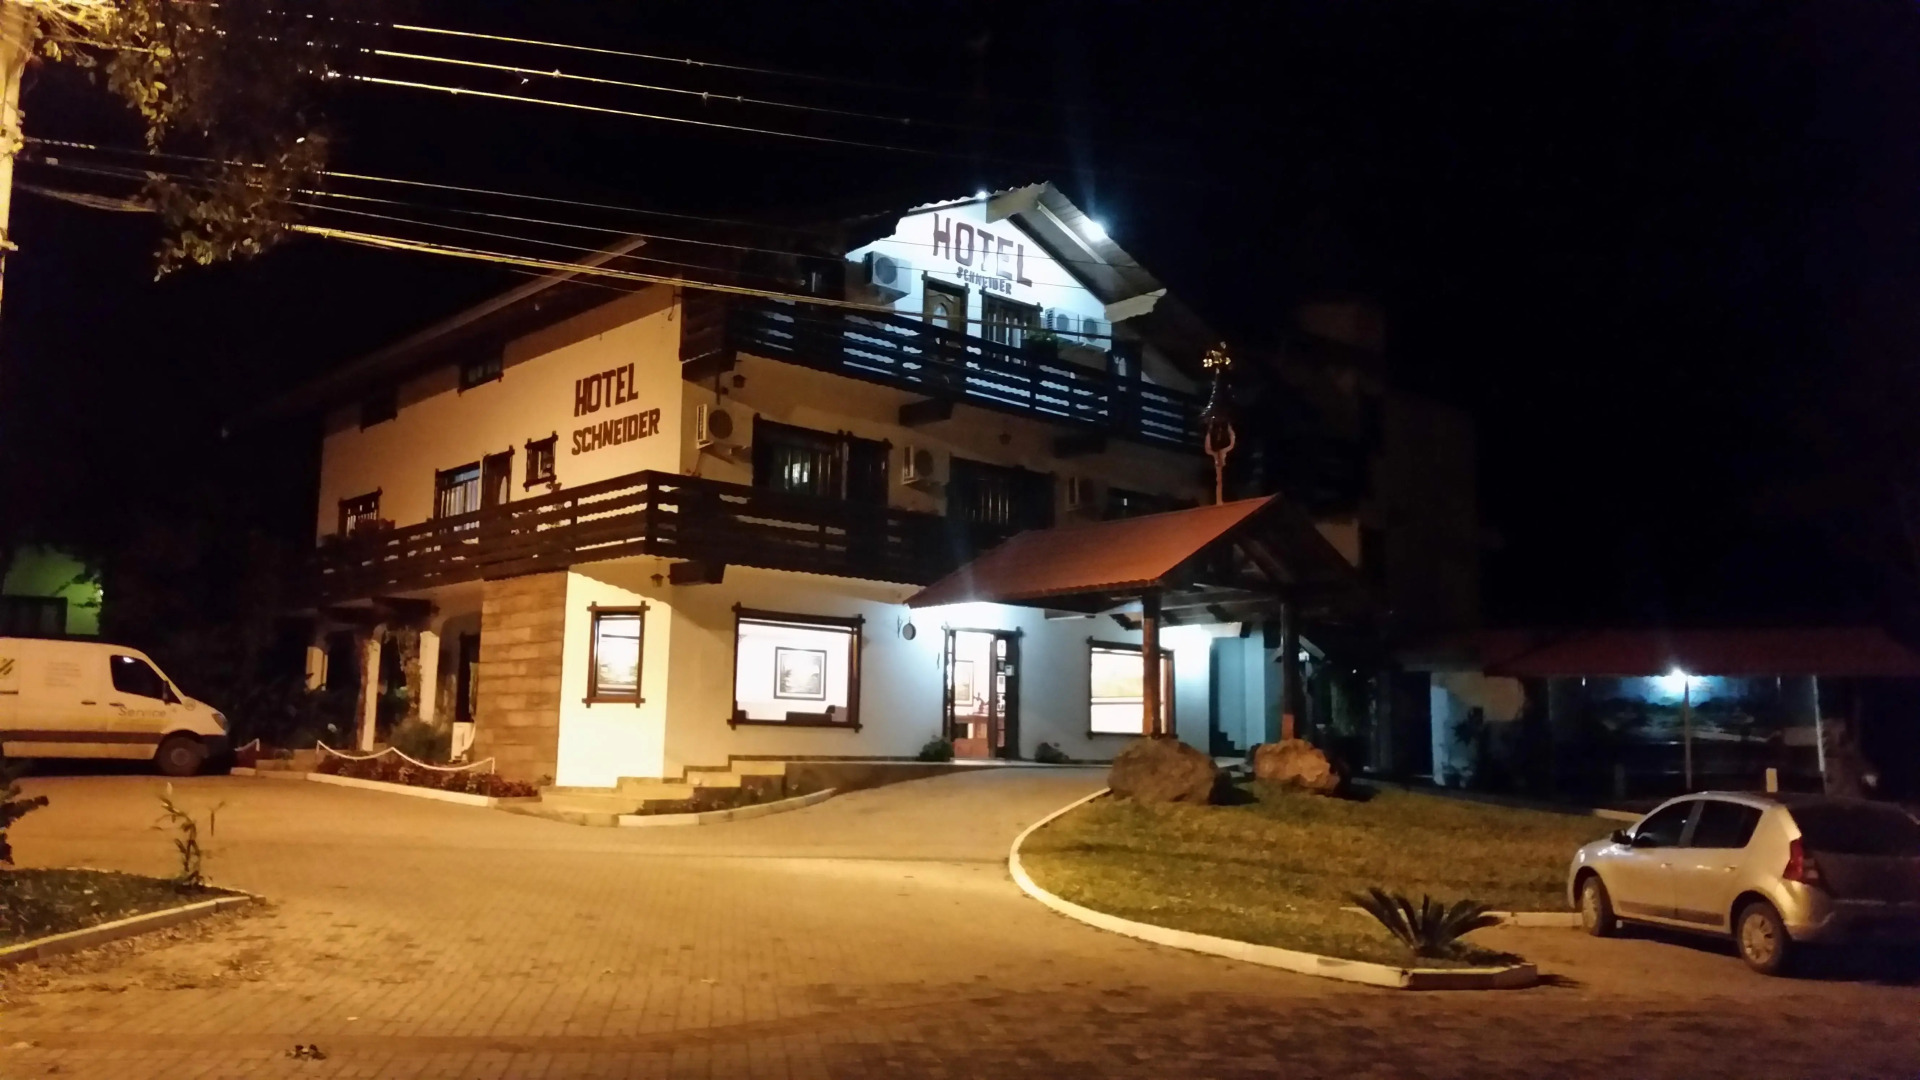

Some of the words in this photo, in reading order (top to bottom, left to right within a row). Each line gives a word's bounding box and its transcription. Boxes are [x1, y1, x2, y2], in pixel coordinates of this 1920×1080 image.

[933, 213, 1032, 287] HOTEL
[956, 266, 1012, 295] SCHNEIDER
[574, 362, 639, 417] HOTEL
[571, 408, 661, 455] SCHNEIDER
